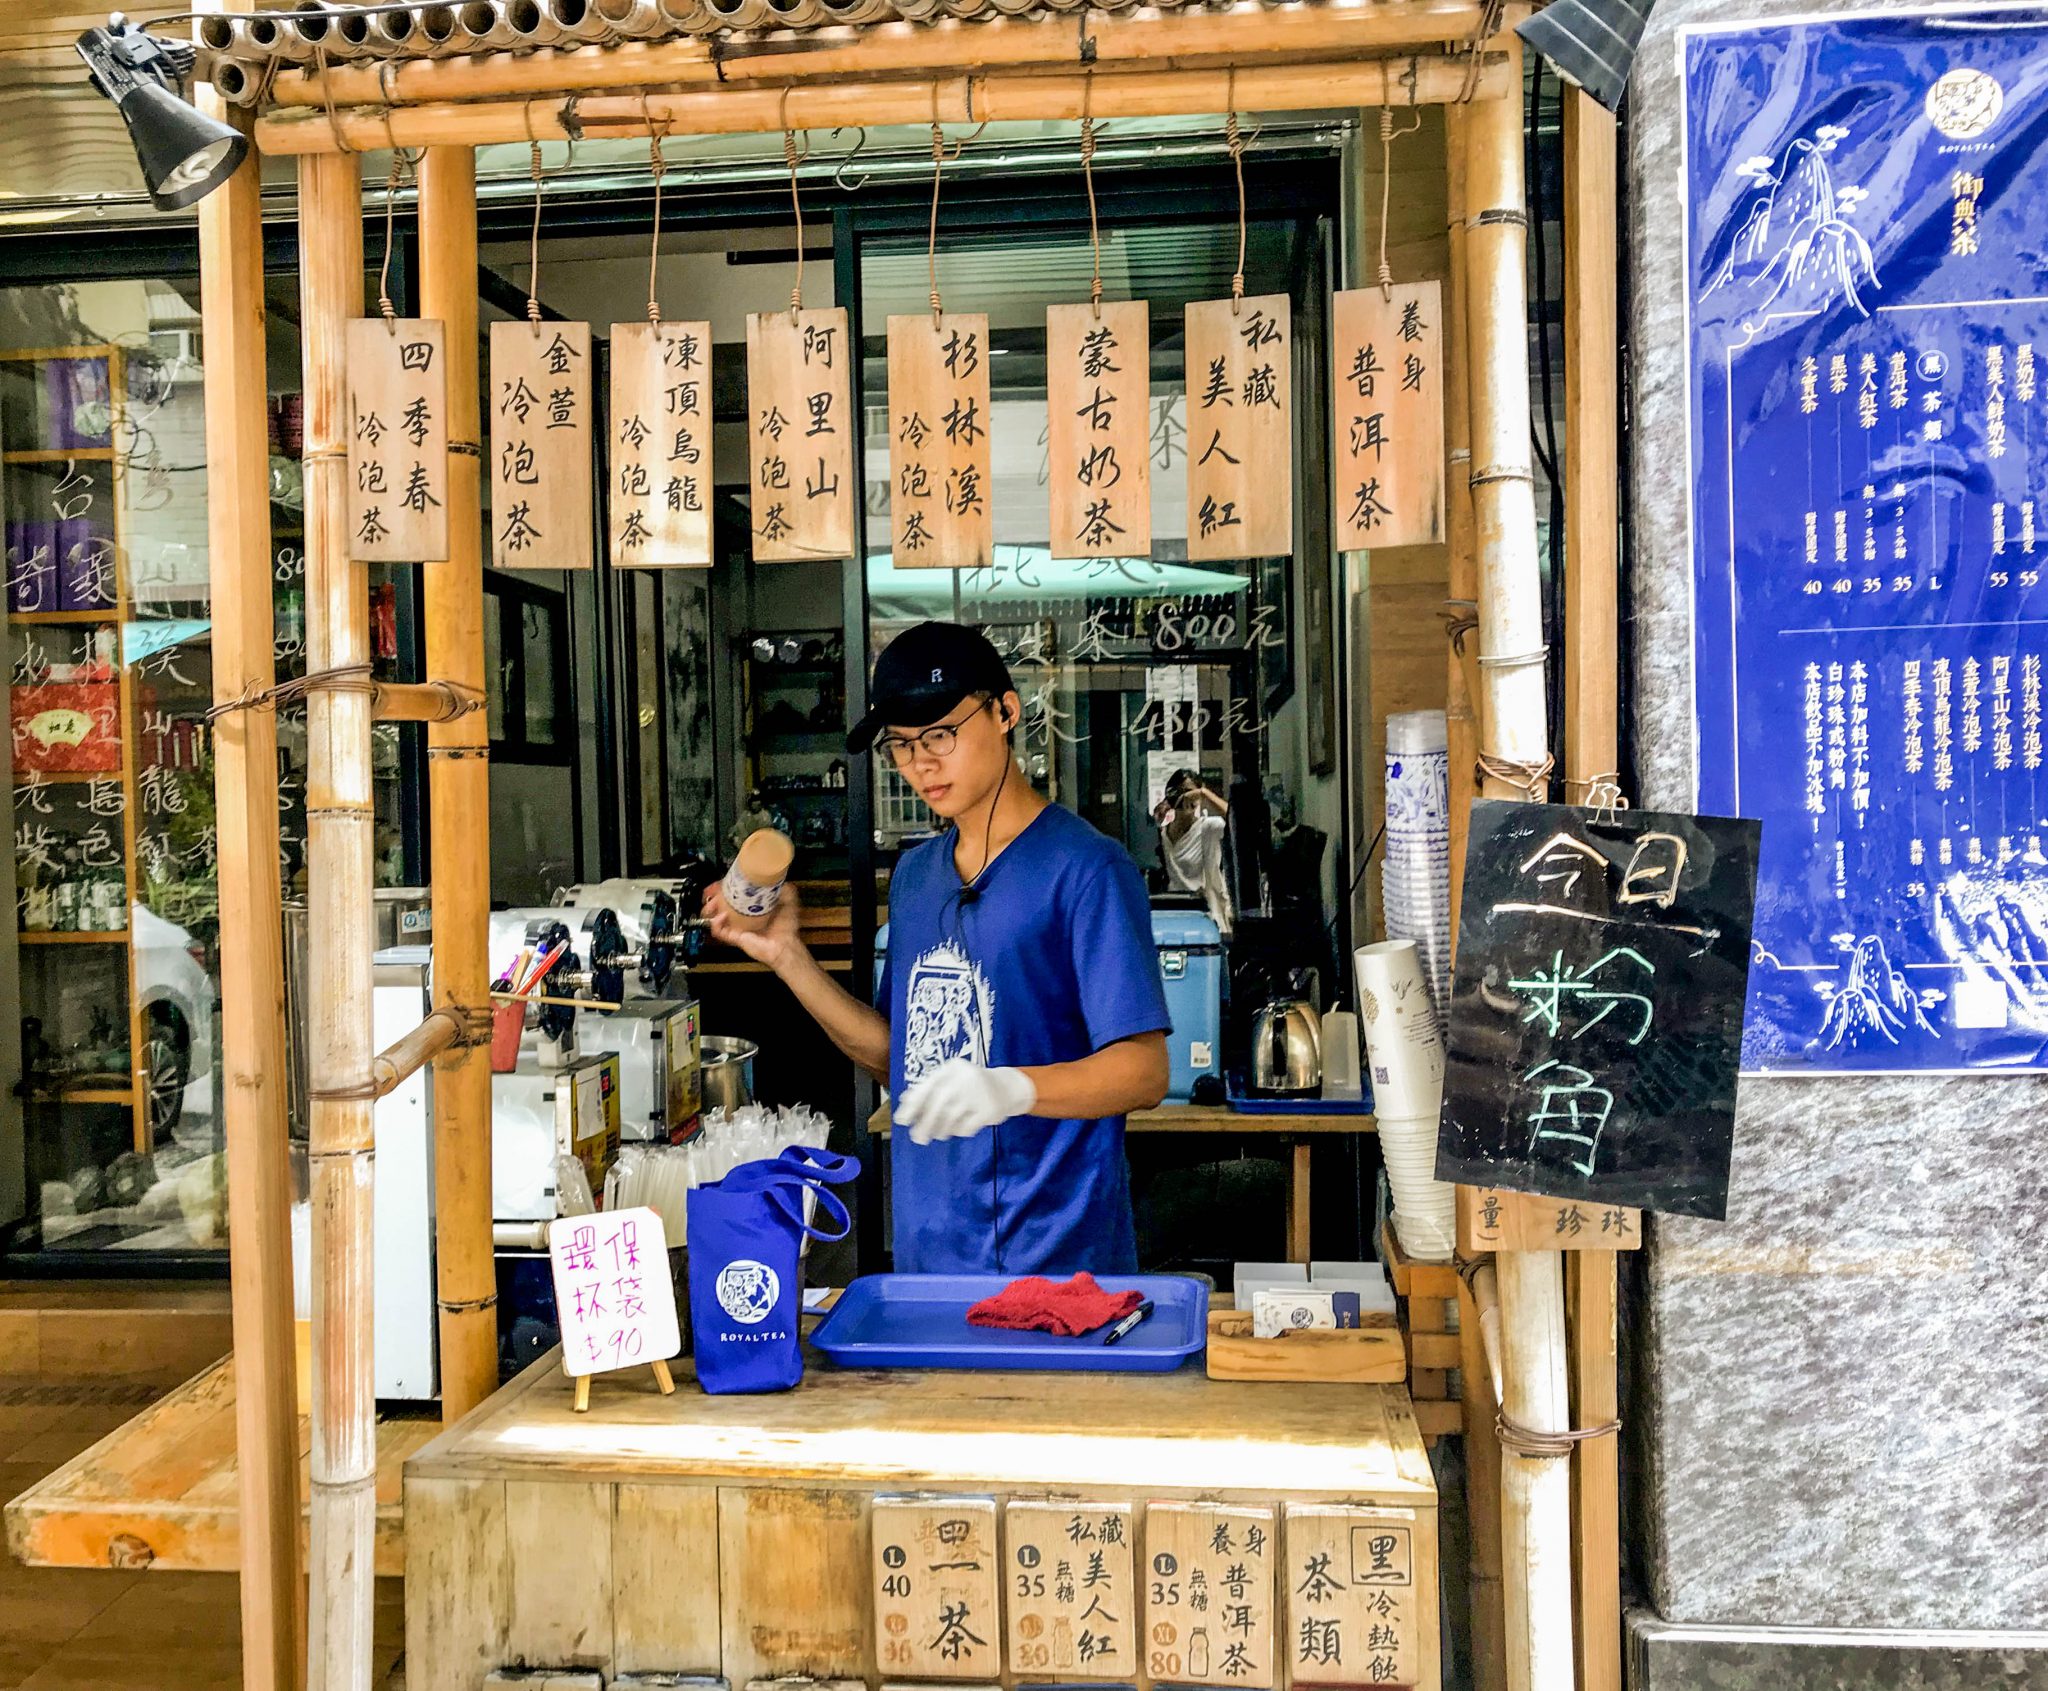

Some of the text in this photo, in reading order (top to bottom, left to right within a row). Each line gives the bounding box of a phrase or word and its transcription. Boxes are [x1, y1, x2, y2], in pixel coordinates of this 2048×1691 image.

[1951, 170, 1984, 257] 御典茶
[540, 332, 583, 430] 金萱
[1241, 310, 1283, 410] 私藏
[1396, 300, 1429, 394] 養身
[1859, 352, 1880, 430] 美人紅茶
[1889, 350, 1909, 410] 普洱茶
[400, 340, 442, 514] 四季春
[663, 338, 704, 513] 凍頂烏龍
[804, 325, 840, 500] 阿里山
[942, 329, 985, 517] 杉林溪
[1076, 328, 1127, 547] 蒙古奶茶
[1197, 354, 1242, 541] 美人紅
[1347, 342, 1395, 532] 普洱茶
[356, 411, 391, 545] 冷泡茶
[500, 376, 542, 551] 冷泡茶
[619, 418, 653, 547] 冷泡茶
[759, 404, 794, 543] 冷泡茶
[899, 414, 933, 550] 冷泡茶
[1803, 579, 1823, 594] 40
[1832, 578, 1852, 593] 40
[1863, 577, 1882, 593] 35
[1892, 575, 1912, 592] 35
[1929, 576, 1942, 590] L
[1990, 571, 2009, 588] 55
[2019, 570, 2039, 587] 55
[1156, 601, 1286, 651] 800元
[930, 668, 943, 683] R
[1904, 659, 1924, 773] 四季春冷泡茶
[1962, 656, 1982, 753] 金萱冷泡茶
[1992, 656, 2012, 770] 阿里山冷泡茶
[2021, 653, 2043, 770] 杉林溪冷泡茶
[1827, 661, 1847, 790] 白珍珠或粉角
[1932, 657, 1953, 791] 凍頂烏龍冷泡茶
[1521, 831, 1688, 909] 今日
[1907, 882, 1926, 897] 35
[1507, 949, 1656, 1178] 粉角
[561, 1220, 642, 1272] 環保
[1554, 1203, 1634, 1240] 珍珠
[580, 1327, 643, 1364] $90
[1065, 1514, 1127, 1549] 私藏
[1210, 1522, 1267, 1557] 養身
[1360, 1535, 1405, 1582] 黑
[882, 1574, 911, 1597] 40
[1017, 1574, 1046, 1597] 35
[1054, 1559, 1075, 1604] 無糖
[1077, 1548, 1119, 1664] 美人紅
[1151, 1583, 1180, 1606] 35
[1188, 1567, 1208, 1613] 無糖
[1218, 1562, 1258, 1678] 普洱茶
[1296, 1552, 1347, 1667] 茶類
[1151, 1652, 1182, 1676] 80
[1366, 1589, 1401, 1683] 冷熱飲
